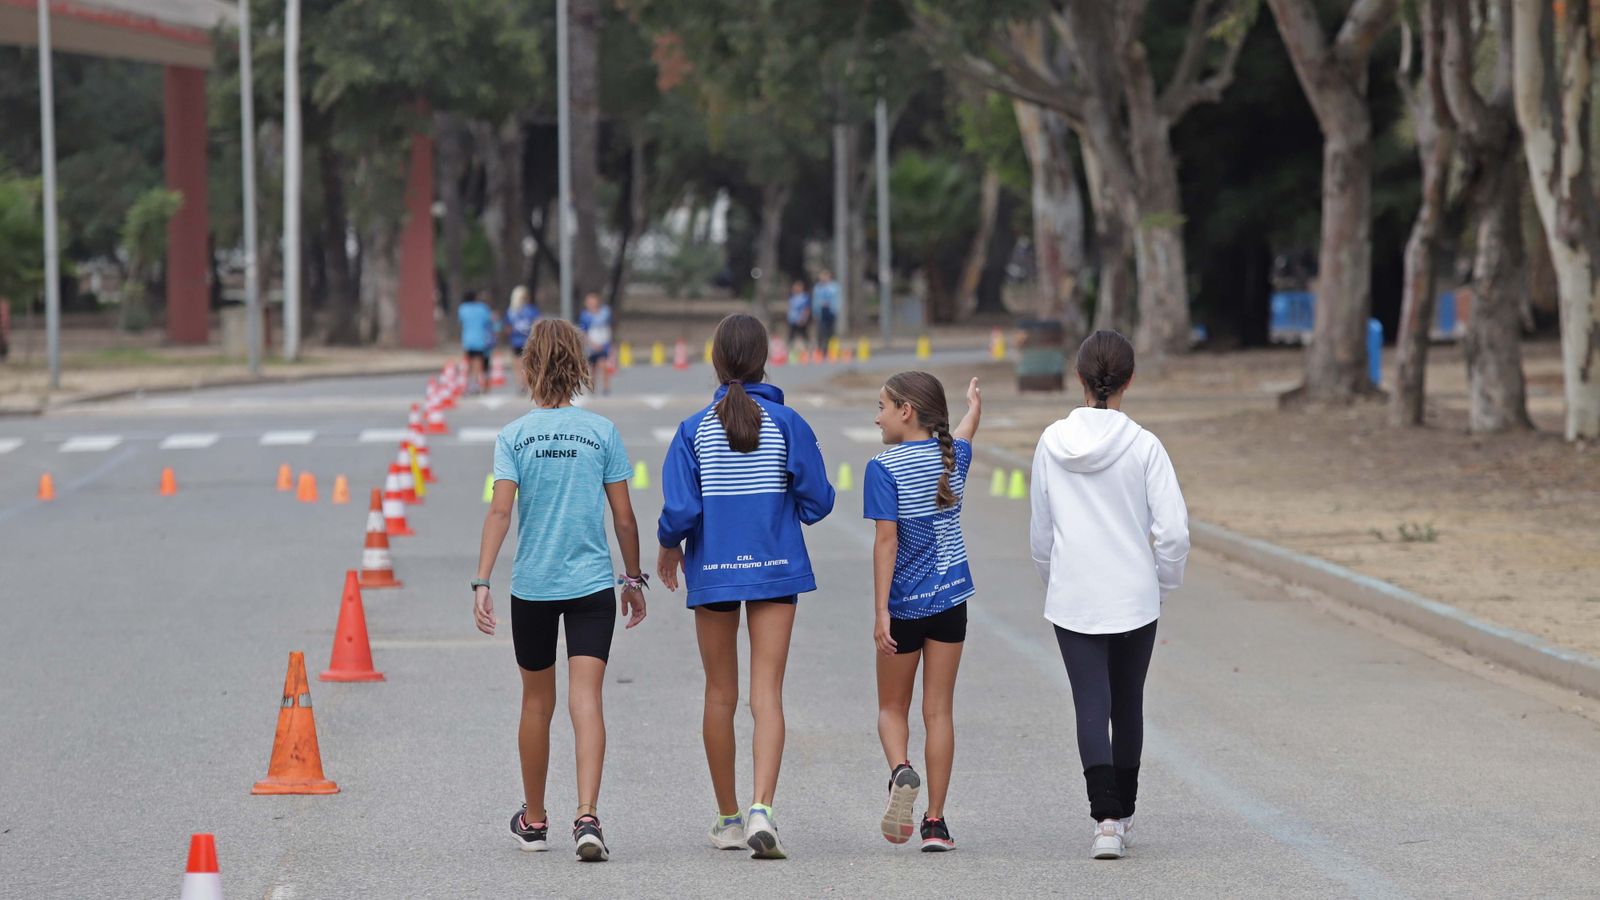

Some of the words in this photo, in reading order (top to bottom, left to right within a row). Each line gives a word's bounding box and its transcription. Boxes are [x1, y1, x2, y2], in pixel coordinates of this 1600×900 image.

[553, 433, 600, 450] ATLETISMO
[536, 450, 577, 458] LINENSE
[720, 561, 762, 569] ATLETISMO
